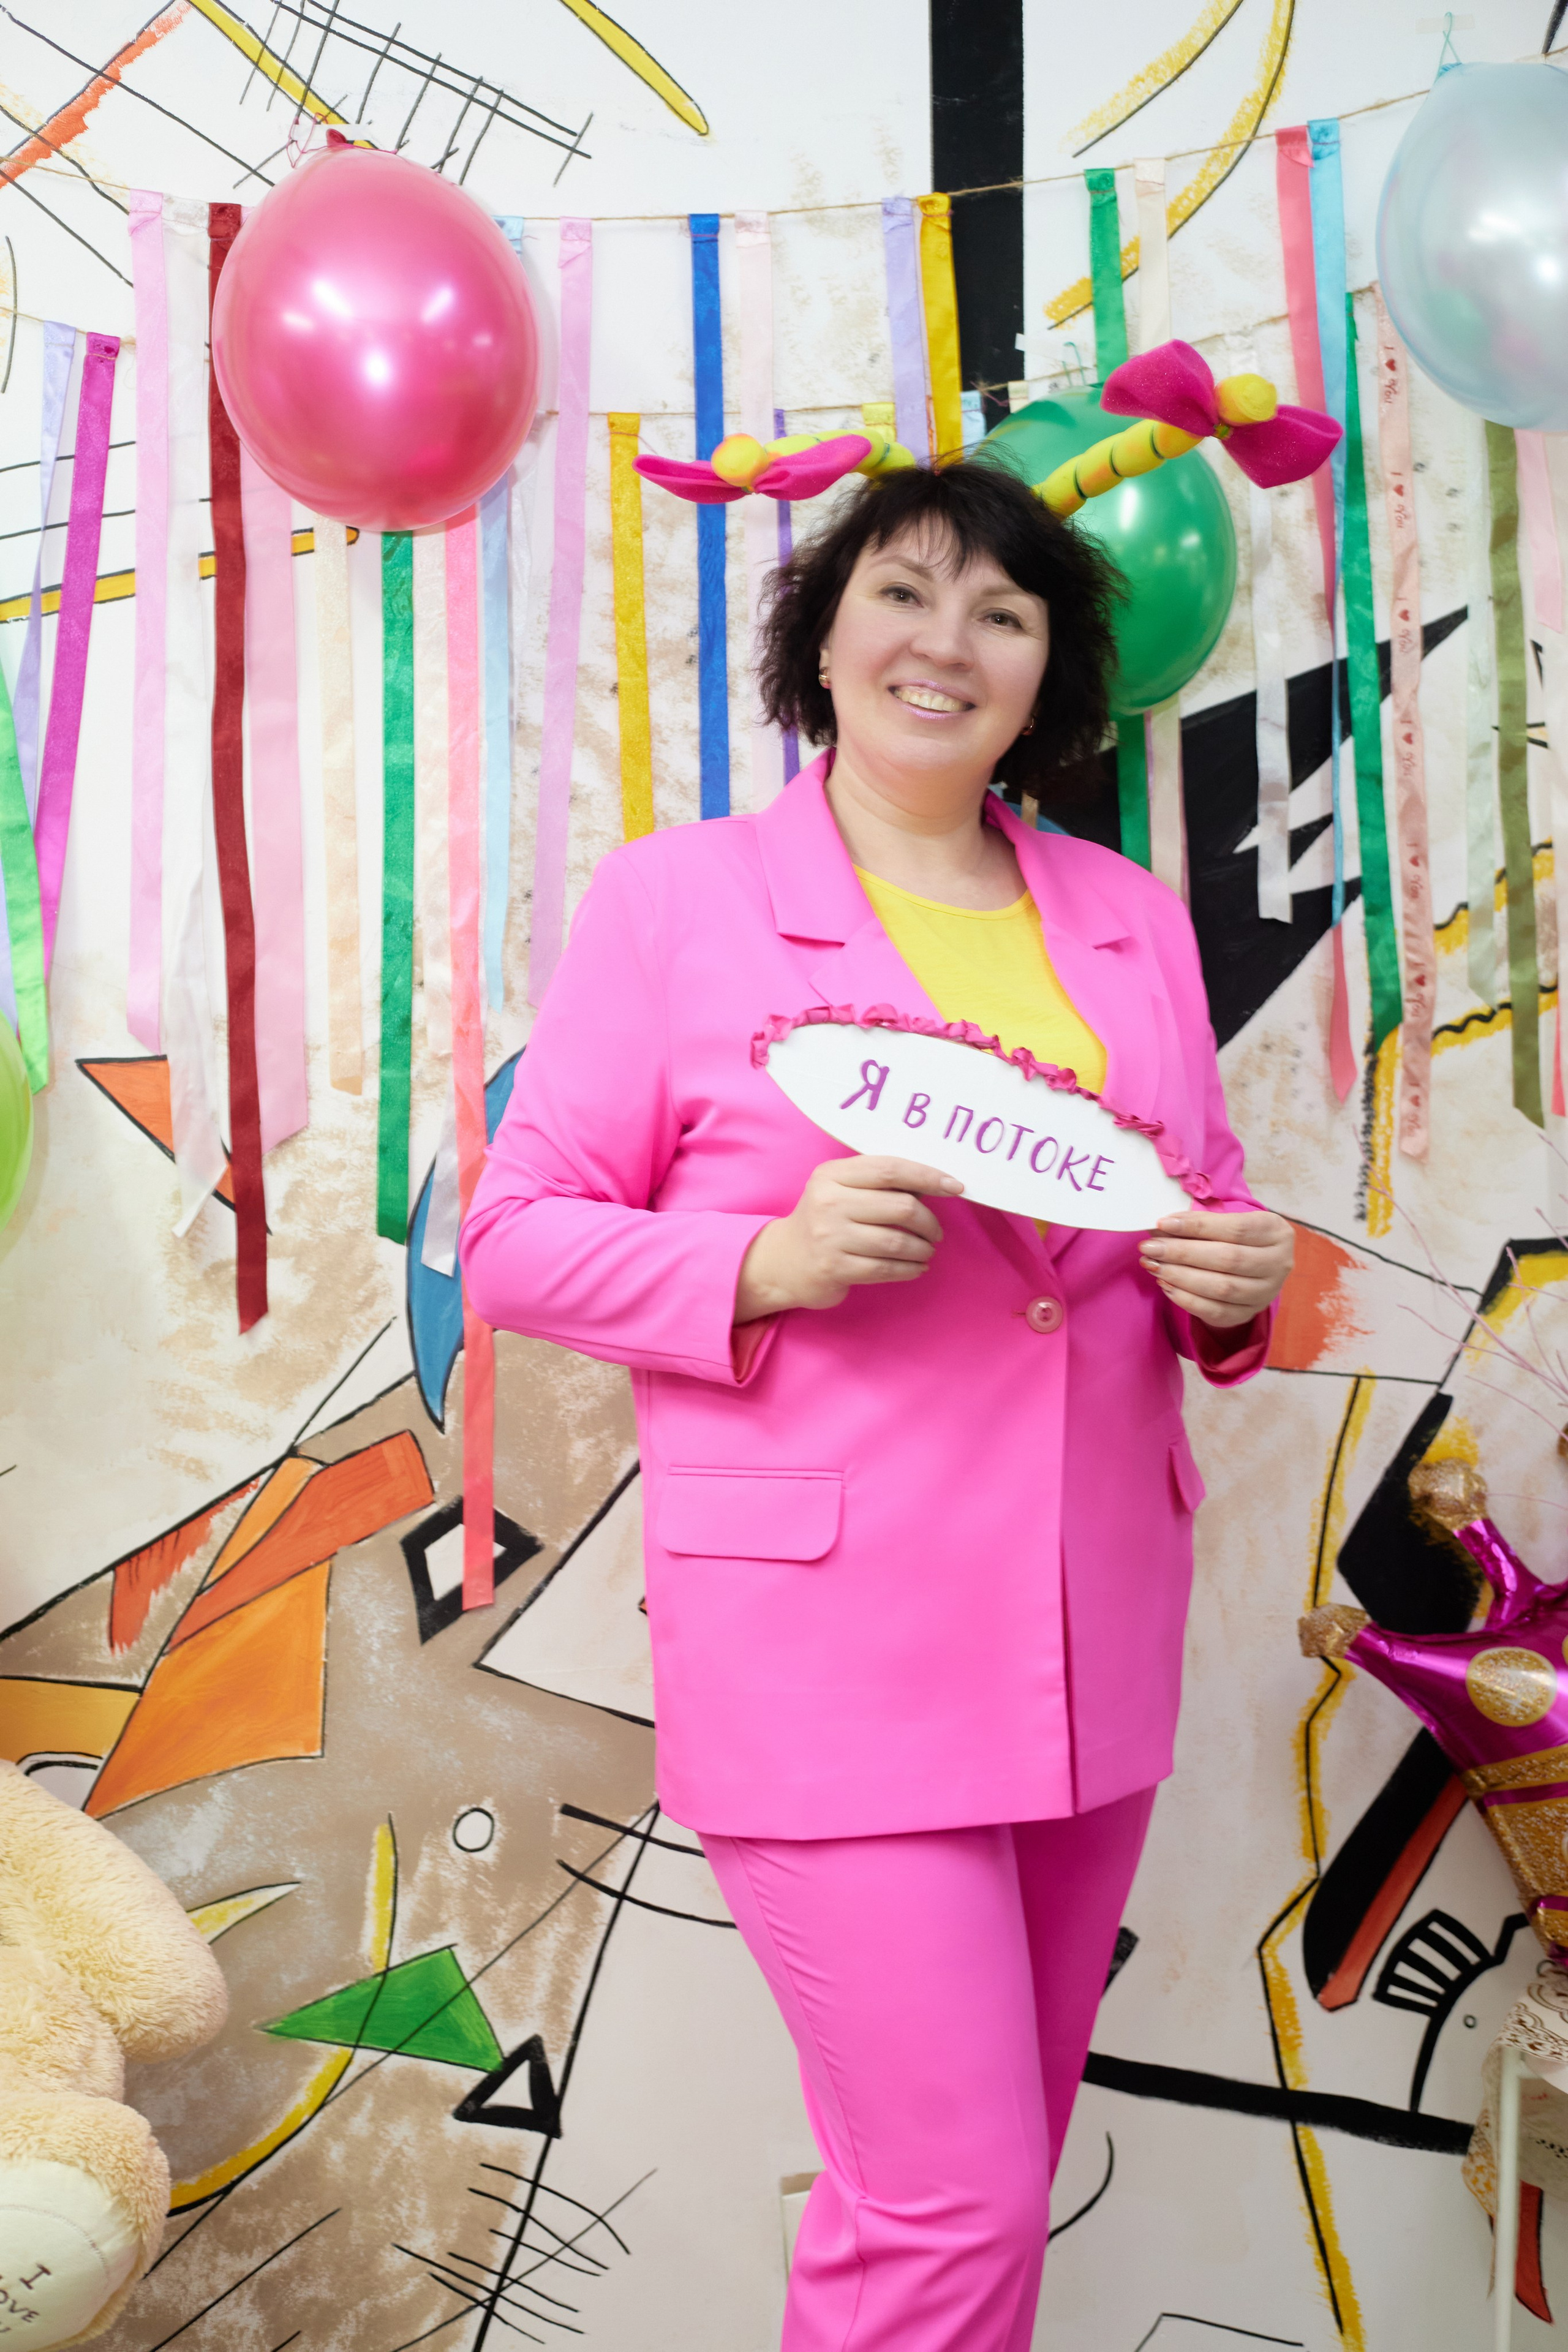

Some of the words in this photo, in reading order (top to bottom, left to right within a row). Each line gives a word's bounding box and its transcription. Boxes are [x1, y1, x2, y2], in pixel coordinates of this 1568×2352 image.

[840, 1059, 890, 1111] Я
[0, 2275, 39, 2323] OVE
[19, 2263, 51, 2290] I
